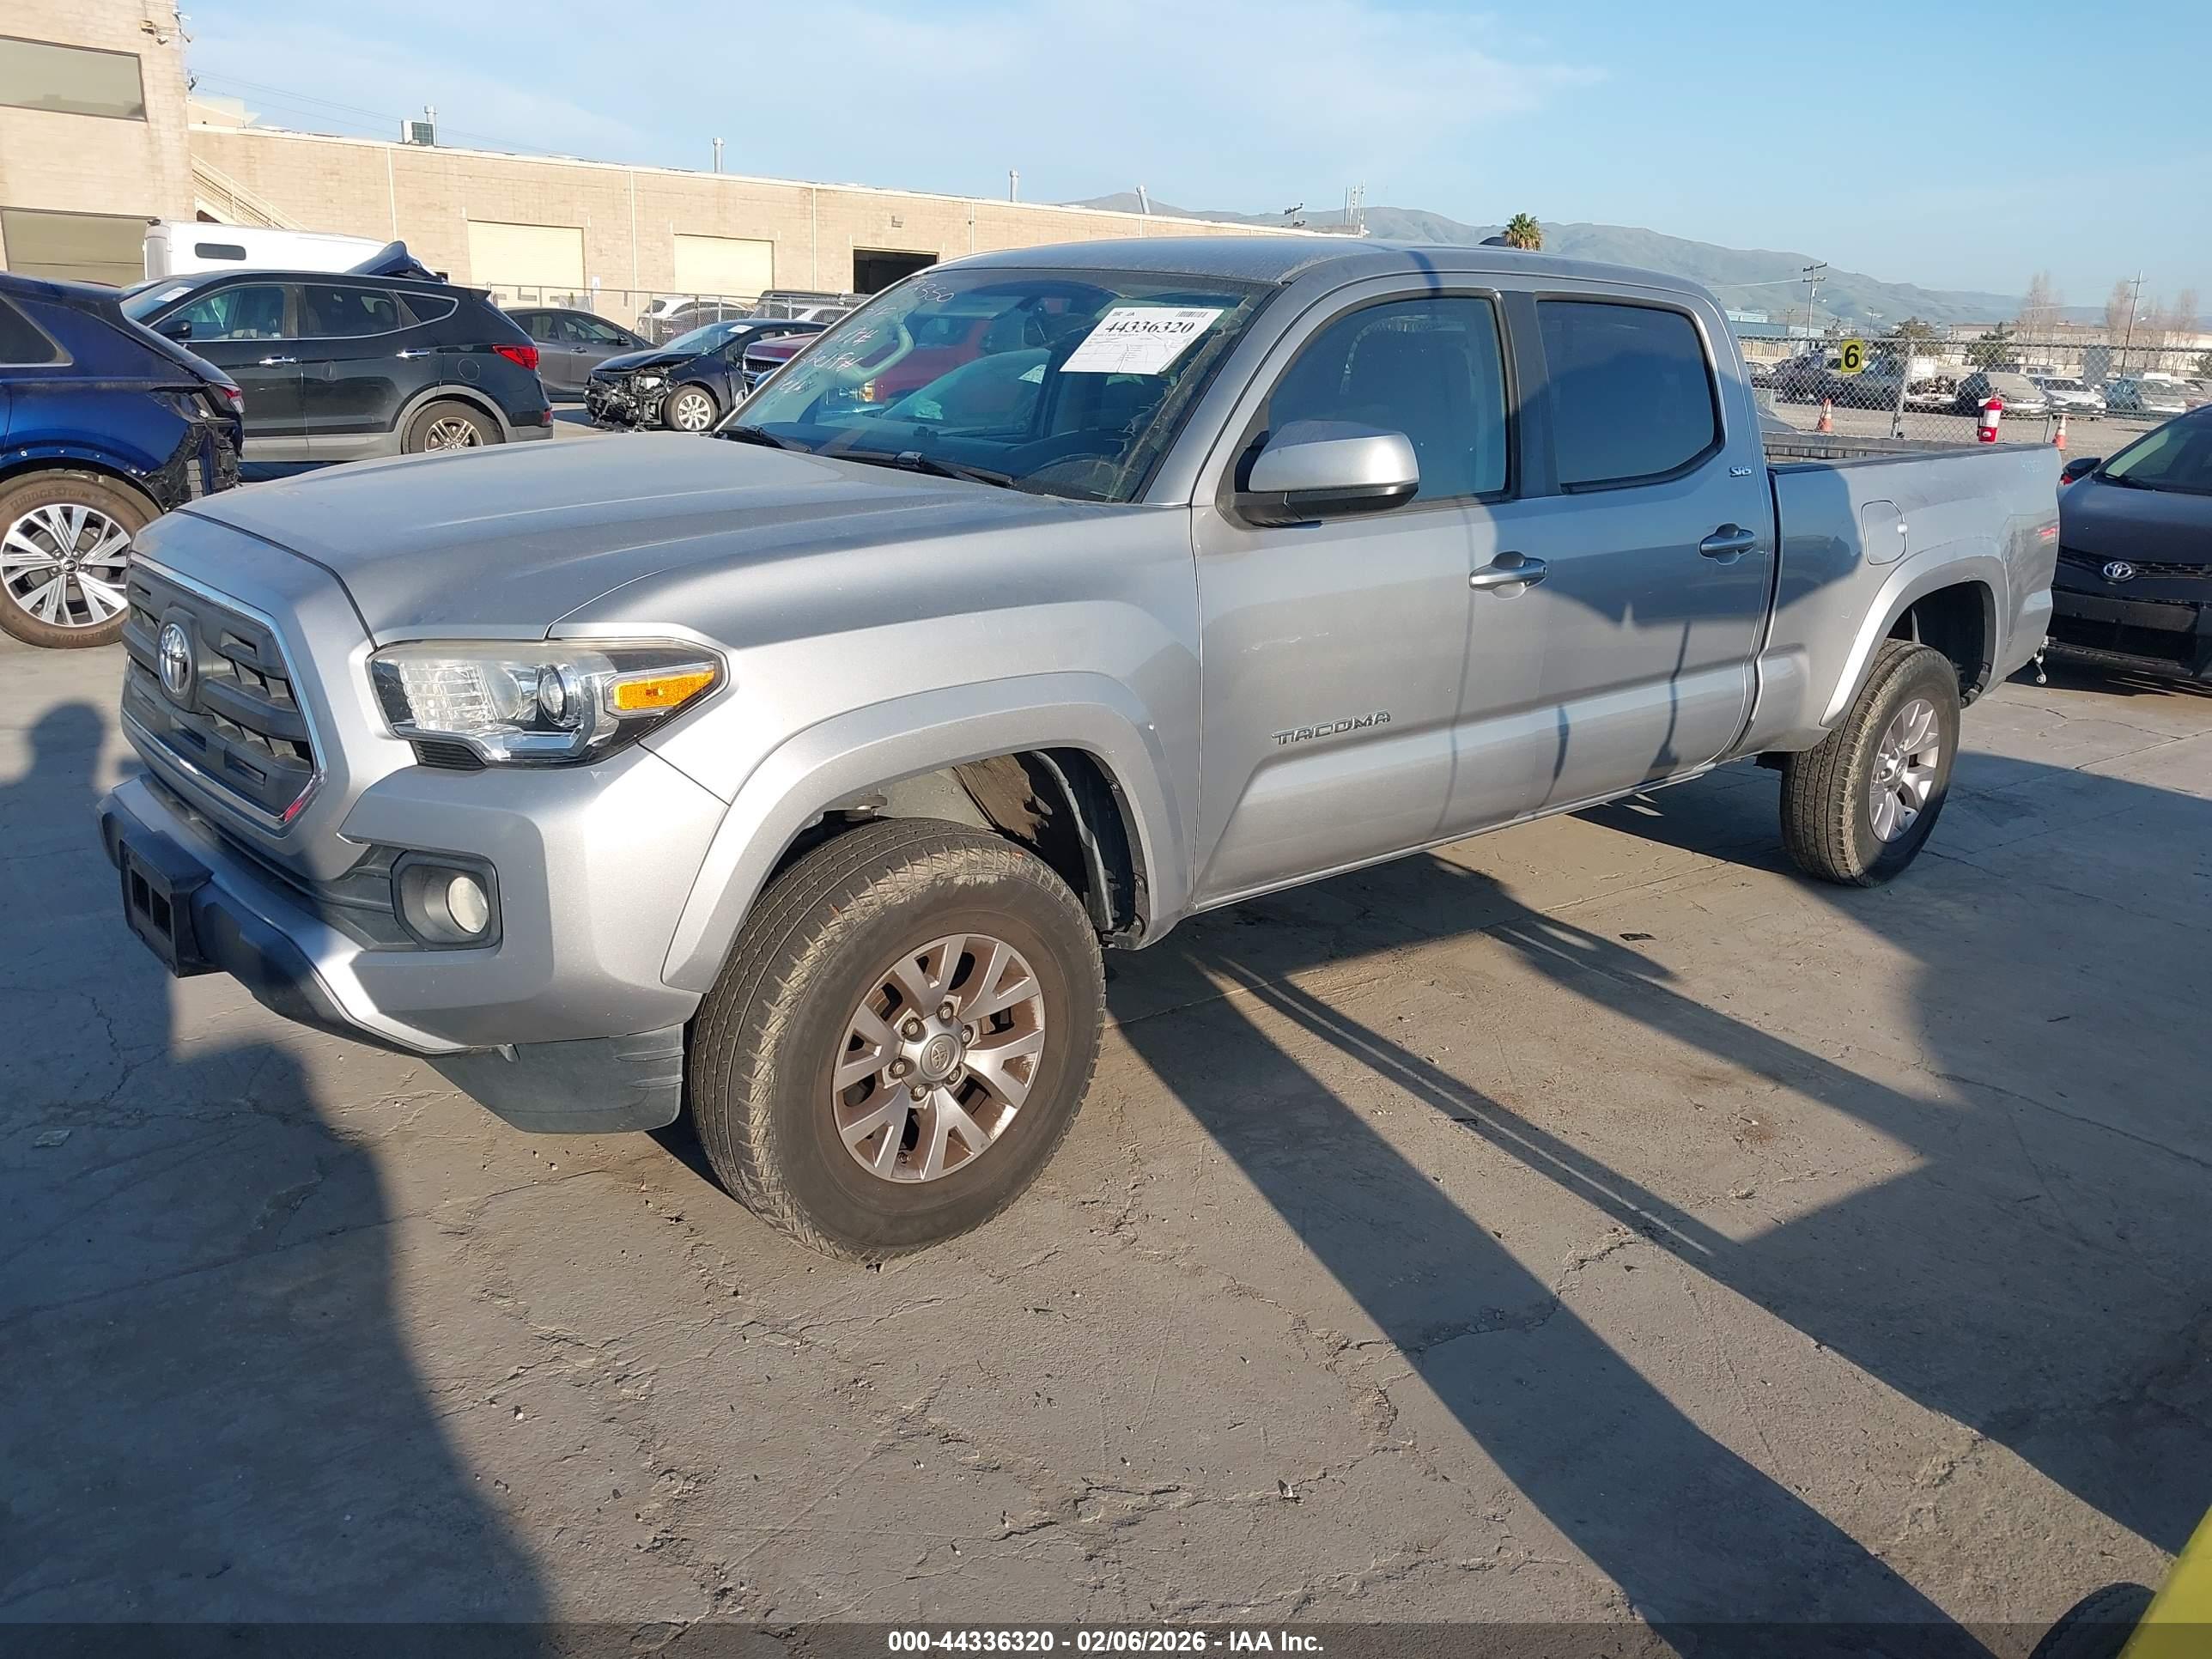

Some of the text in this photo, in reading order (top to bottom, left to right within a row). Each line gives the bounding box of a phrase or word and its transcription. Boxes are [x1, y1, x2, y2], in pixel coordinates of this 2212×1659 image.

[1105, 321, 1195, 334] 44336320
[1844, 343, 1860, 369] 6
[1271, 708, 1391, 744] TACOMA
